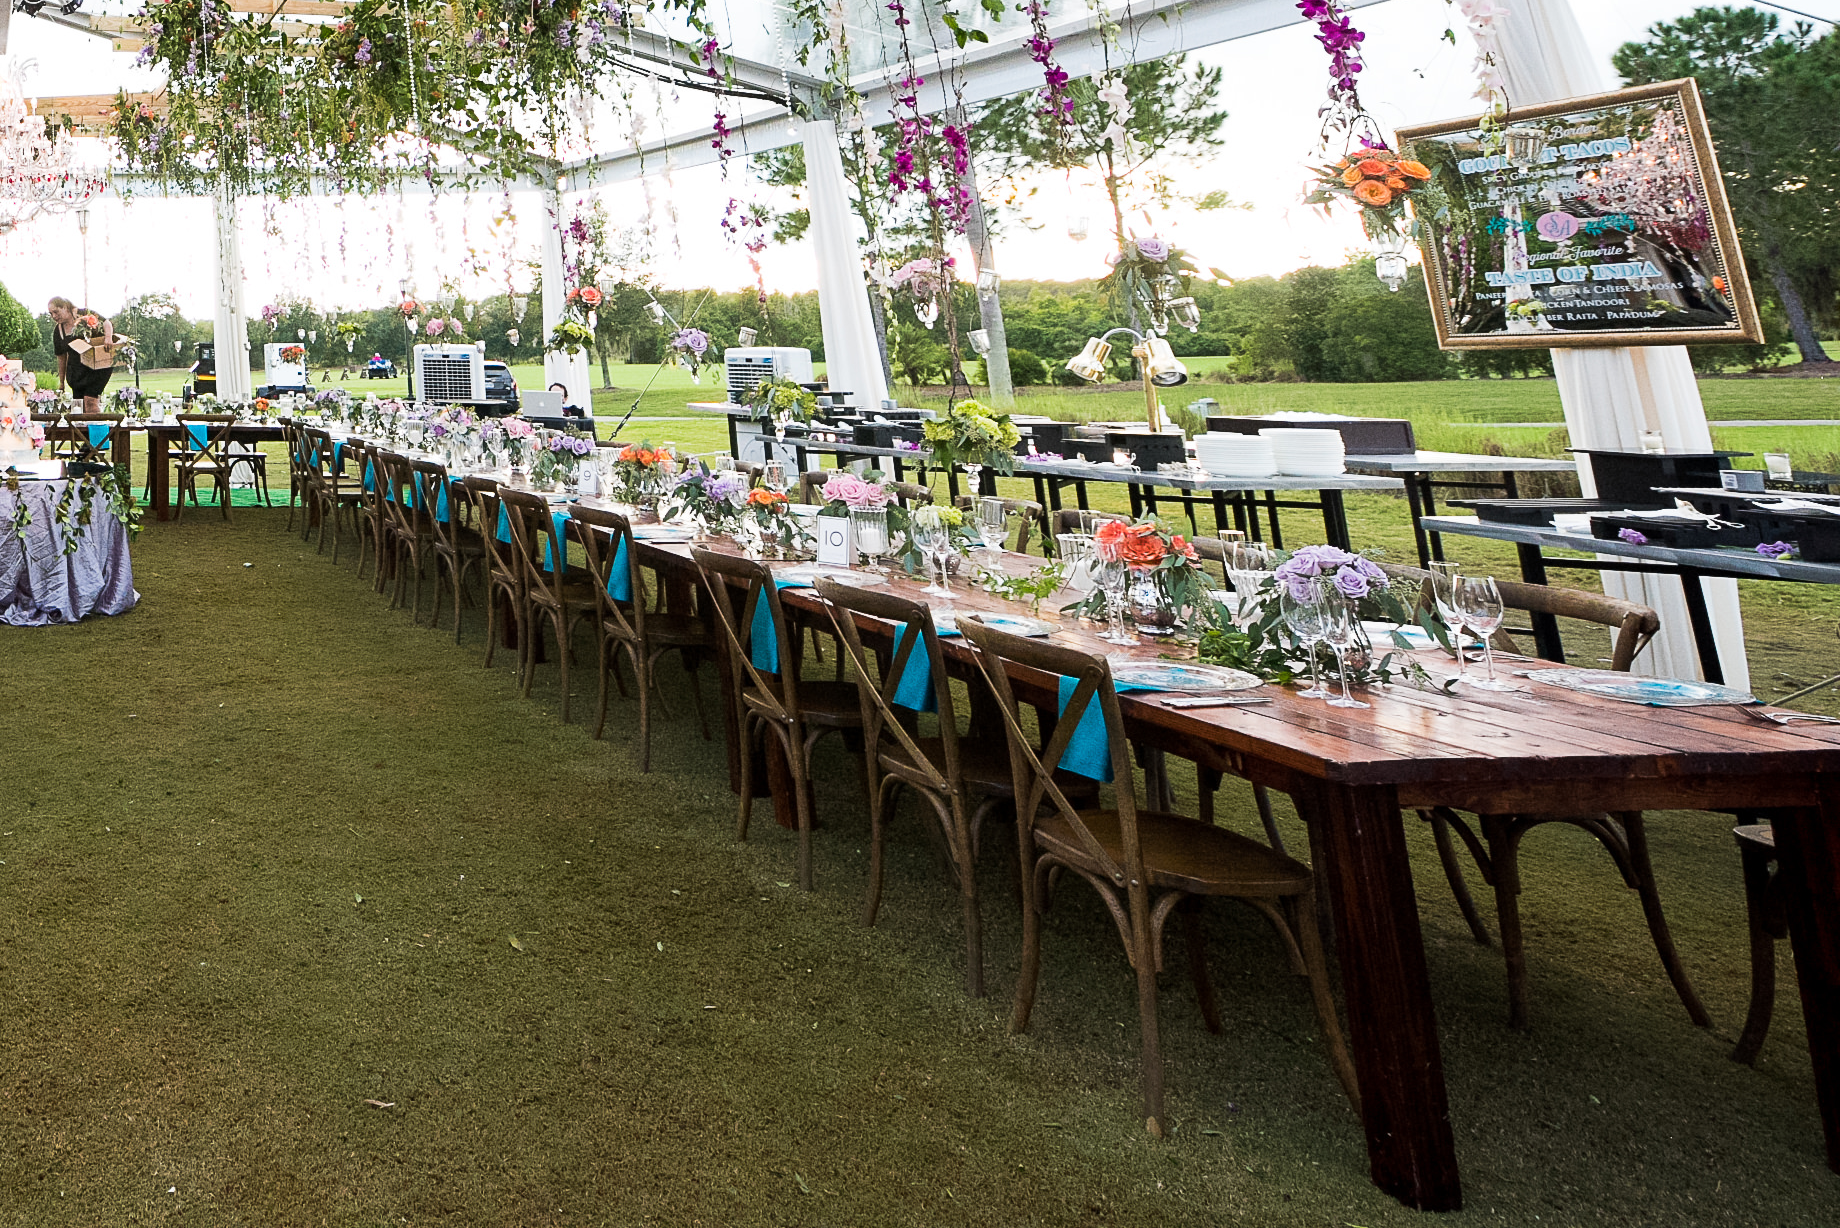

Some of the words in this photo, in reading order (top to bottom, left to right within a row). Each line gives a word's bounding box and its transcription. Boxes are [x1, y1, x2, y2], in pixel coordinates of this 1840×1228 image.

[1548, 124, 1599, 141] Border
[1559, 136, 1632, 161] TACOS
[1568, 245, 1625, 261] Favorite
[1485, 268, 1556, 286] TASTE
[1556, 266, 1589, 282] OF
[1590, 261, 1663, 281] INDIA
[1582, 286, 1591, 294] &
[1593, 285, 1631, 294] CHEESE
[1633, 282, 1684, 293] SAMOSAS
[1574, 298, 1630, 308] TANDOORI
[1566, 312, 1598, 321] RAITA
[583, 470, 592, 481] 9
[824, 530, 844, 547] 10
